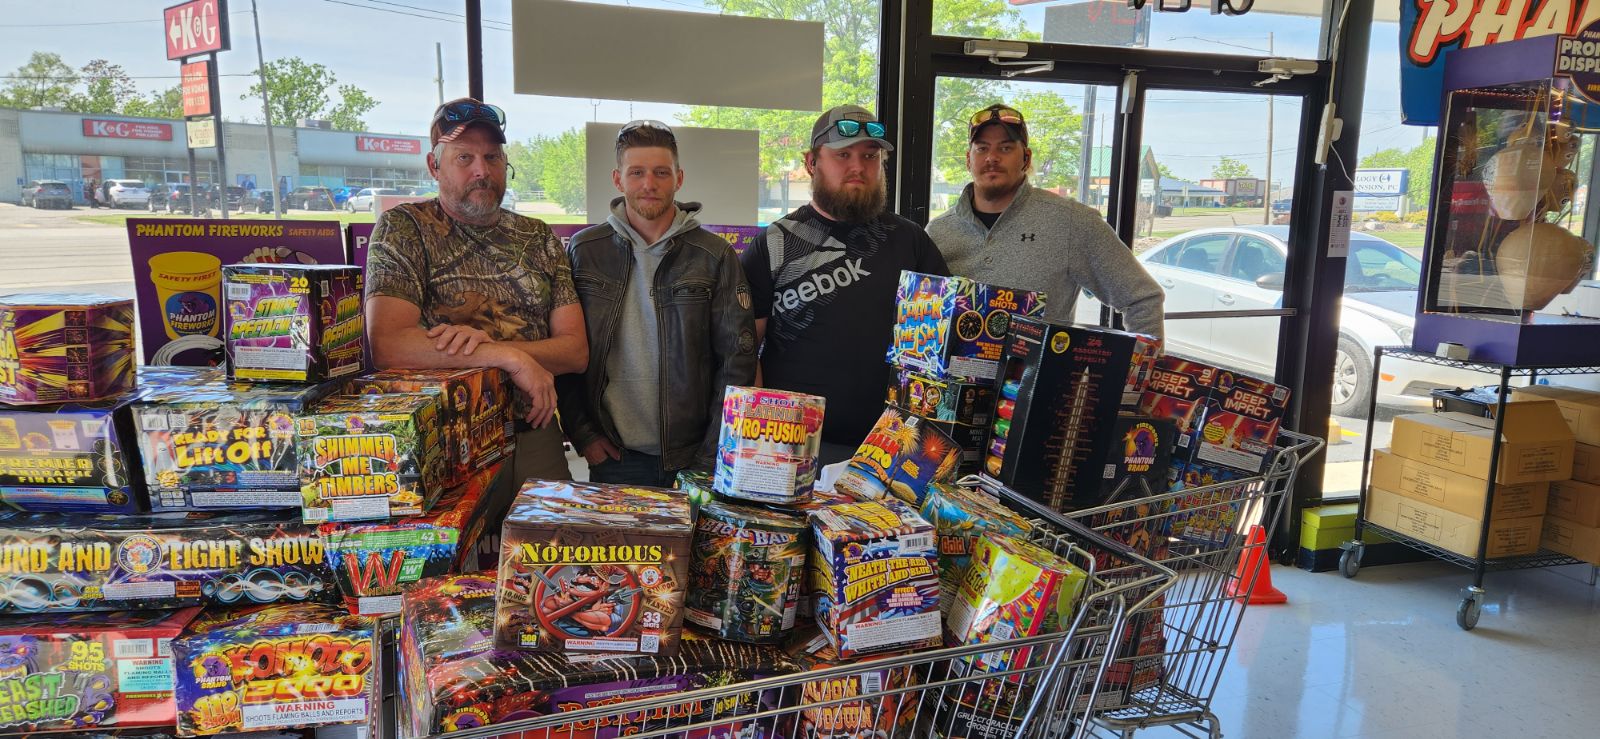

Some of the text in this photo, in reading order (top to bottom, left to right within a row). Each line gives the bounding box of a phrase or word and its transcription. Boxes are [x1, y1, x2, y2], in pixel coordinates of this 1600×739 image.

[180, 1, 217, 50] K&G
[1414, 0, 1600, 57] PHA
[1561, 39, 1600, 57] PRO
[136, 224, 205, 237] PHANTOM
[209, 224, 284, 237] FIREWORKS
[288, 228, 317, 237] SAFETY
[158, 270, 217, 282] SAFETY FIRST
[290, 277, 309, 288] 20
[771, 257, 872, 316] Reebok
[997, 289, 1015, 302] 20
[899, 296, 943, 323] CRACK
[989, 299, 1018, 311] SHOTS
[169, 309, 215, 322] PHANTOM
[170, 317, 215, 330] FIREWORKS
[1151, 369, 1190, 386] DEEP
[1147, 382, 1195, 398] MPACT
[1234, 389, 1268, 406] DEEP
[1224, 397, 1272, 420] IMPACT
[174, 426, 266, 445] READY FOR
[732, 416, 807, 445] PYRO-FUSION
[175, 440, 272, 468] Lift Off
[315, 436, 395, 467] SHIMMER
[856, 443, 893, 469] PYRO
[1124, 456, 1155, 464] PHANTOM
[342, 457, 370, 475] ME
[1127, 464, 1150, 472] BRAND
[18, 476, 76, 484] FINALE
[320, 474, 398, 497] TIMBERS
[420, 532, 435, 541] 42
[750, 530, 792, 546] BAD
[250, 536, 324, 566] SHOW
[520, 543, 662, 563] NOTORIOUS
[942, 536, 966, 555] Gold
[58, 542, 111, 572] AND
[165, 539, 241, 570] LIGHT
[889, 558, 909, 569] THE
[910, 556, 928, 567] RED
[845, 576, 887, 602] WHITE
[888, 570, 910, 585] AND
[910, 565, 932, 578] BLUE
[643, 611, 661, 624] 33
[521, 634, 537, 642] 500
[71, 640, 105, 660] 95
[68, 660, 105, 672] SHOTS
[224, 637, 373, 684] KOMODO
[195, 675, 232, 684] PHANTOM
[245, 675, 365, 702] 3000
[0, 695, 78, 723] EASHED
[245, 708, 363, 723] SHOOTS FLAMING BALLS AND REPORTS
[275, 702, 335, 713] WARNING
